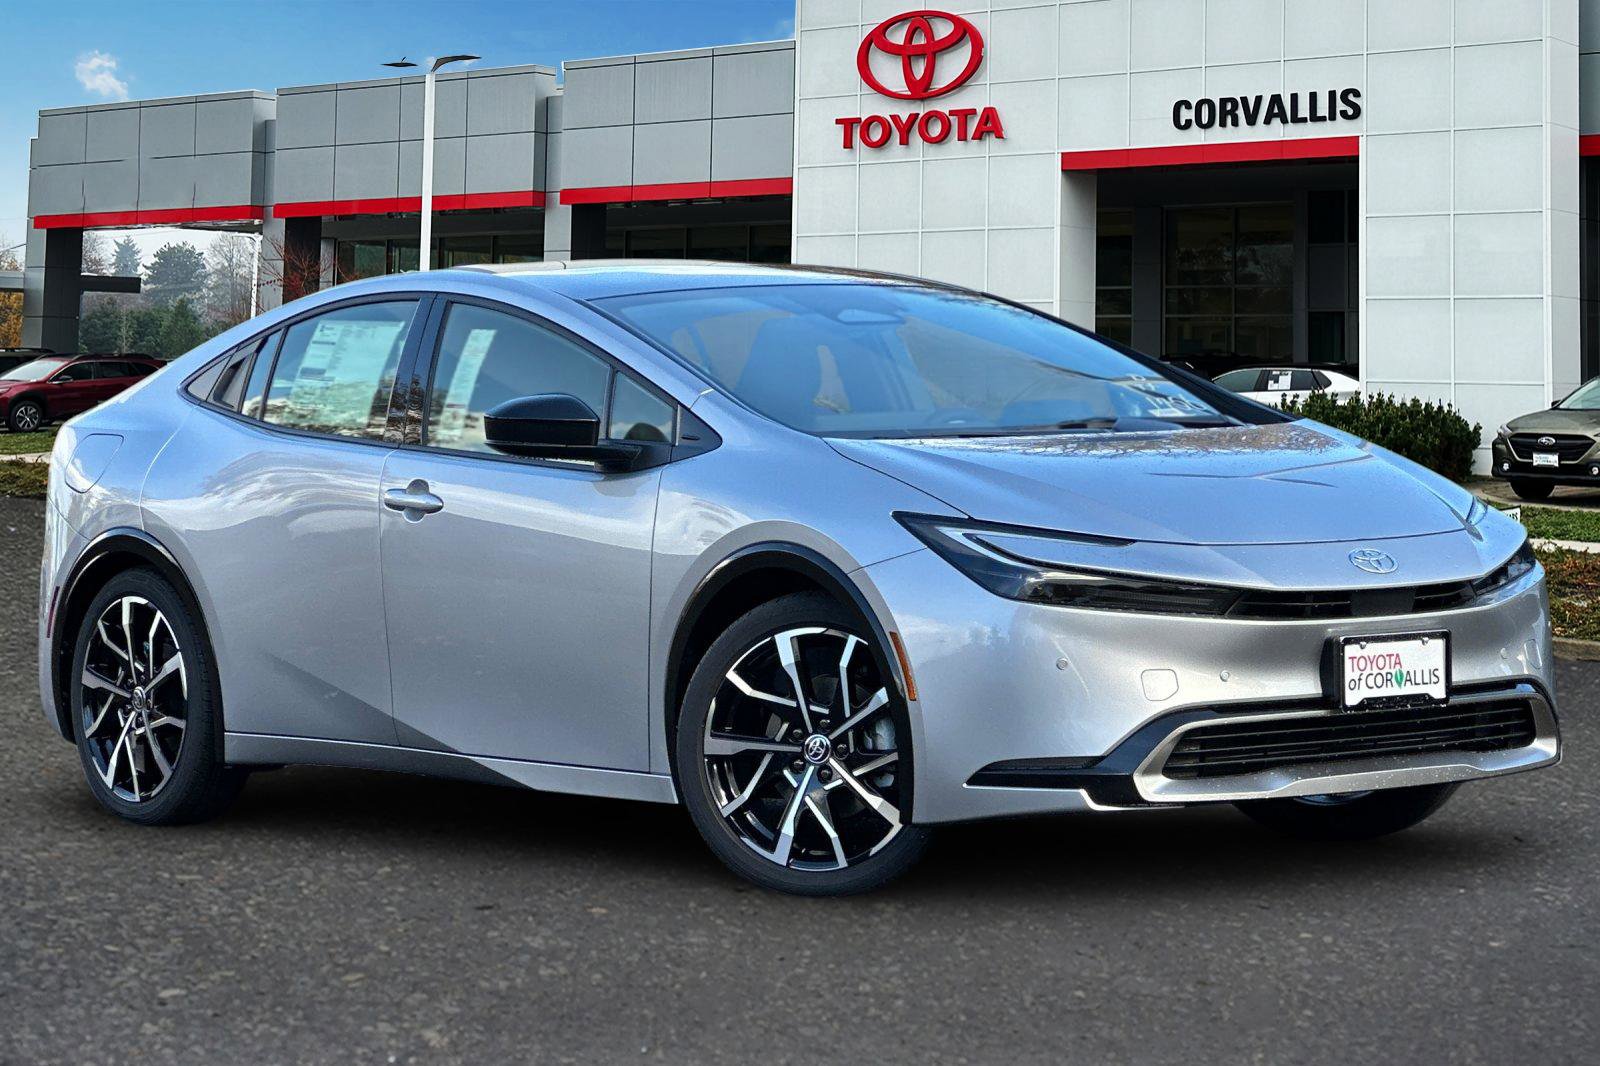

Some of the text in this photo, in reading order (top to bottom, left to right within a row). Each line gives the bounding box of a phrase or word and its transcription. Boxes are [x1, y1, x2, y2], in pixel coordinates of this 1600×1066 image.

[1172, 87, 1362, 131] CORVALLIS
[835, 106, 1004, 149] TOYOTA
[1348, 653, 1403, 672] TOYOTA
[1348, 668, 1440, 691] of CORVALLIS
